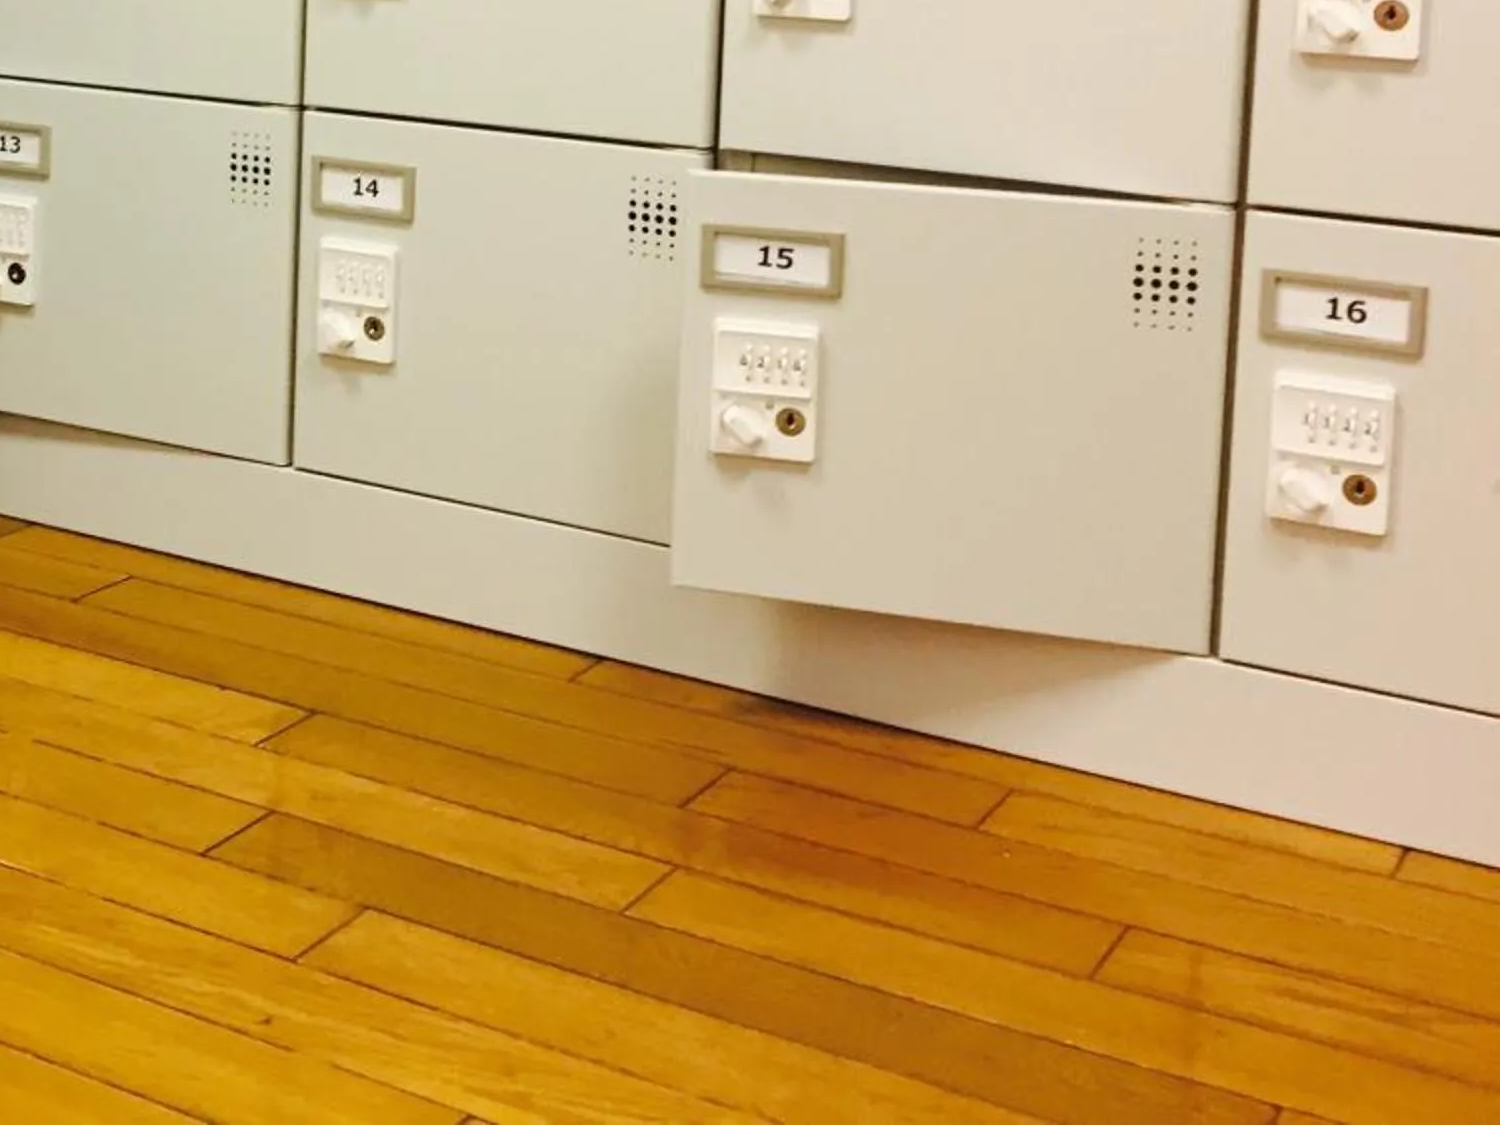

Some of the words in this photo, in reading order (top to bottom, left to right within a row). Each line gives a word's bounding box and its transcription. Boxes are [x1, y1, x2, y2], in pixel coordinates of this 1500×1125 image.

[0, 135, 22, 154] 13
[352, 178, 380, 198] 14
[757, 245, 795, 270] 15
[1326, 297, 1367, 324] 16
